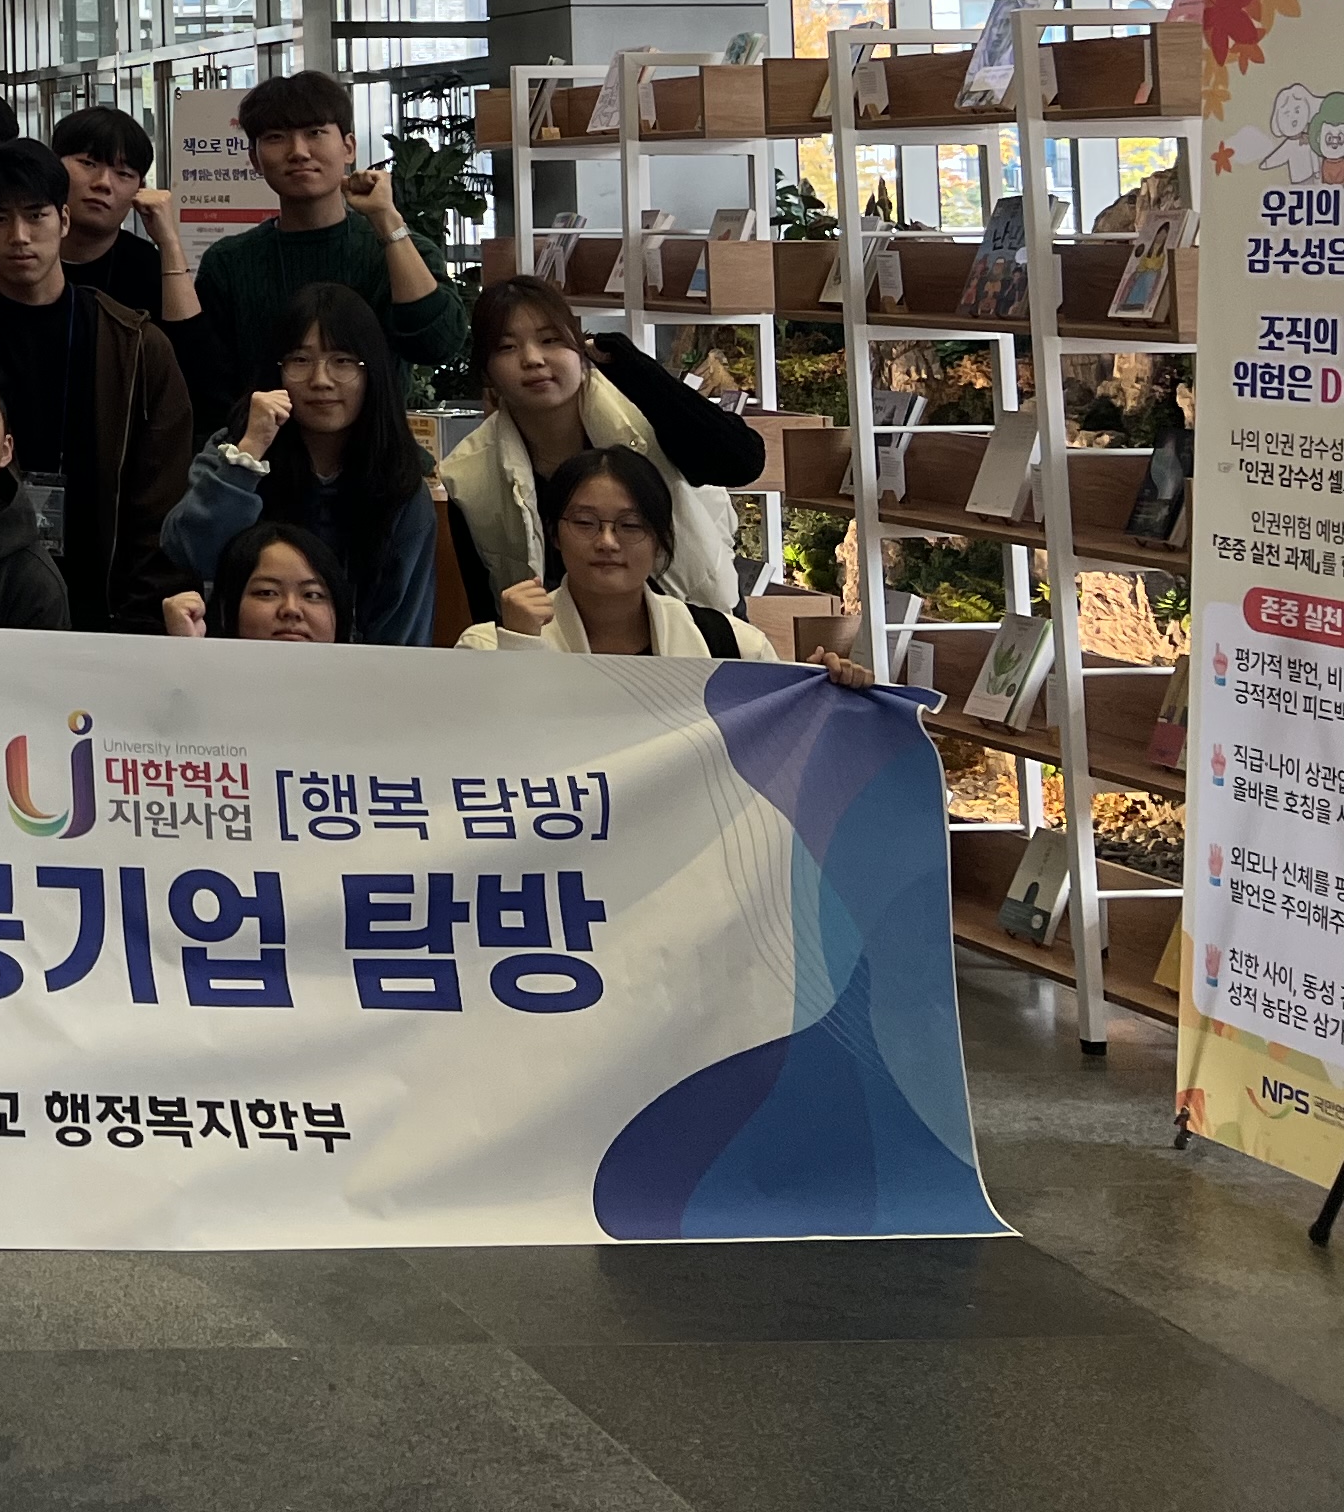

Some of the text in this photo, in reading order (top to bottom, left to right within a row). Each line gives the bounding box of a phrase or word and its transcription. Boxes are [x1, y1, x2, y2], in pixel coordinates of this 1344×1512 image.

[183, 137, 222, 157] 책으로
[1261, 189, 1341, 227] 우리의
[1258, 316, 1338, 356] 조직의
[1233, 361, 1313, 403] 위험은
[1230, 428, 1260, 454] 나의
[1264, 432, 1294, 457] 인권
[1278, 464, 1324, 492] 감수성
[1251, 510, 1312, 541] 인권위험
[1250, 541, 1281, 568] 실천
[1260, 595, 1344, 636] 존중 실천
[1235, 648, 1283, 680] 평가적
[1288, 657, 1323, 691] 발언,
[103, 737, 172, 759] University
[105, 757, 251, 800] 대학혁신
[108, 799, 253, 842] 지원사업
[275, 768, 613, 842] [행복 탐방]
[1233, 776, 1280, 811] 올바른
[1283, 790, 1332, 826] 호칭을
[1230, 846, 1278, 882] 외모나
[1282, 861, 1331, 898] 신체를
[1230, 877, 1277, 915] 발언은
[340, 870, 607, 1015] 탐방
[1228, 947, 1260, 980] 친한
[1263, 961, 1297, 997] 사이,
[1302, 973, 1335, 1007] 동성
[1228, 981, 1258, 1014] 성적
[1262, 991, 1309, 1032] 농담은
[1261, 1075, 1310, 1115] NPS
[44, 1090, 352, 1154] 행정복지학부
